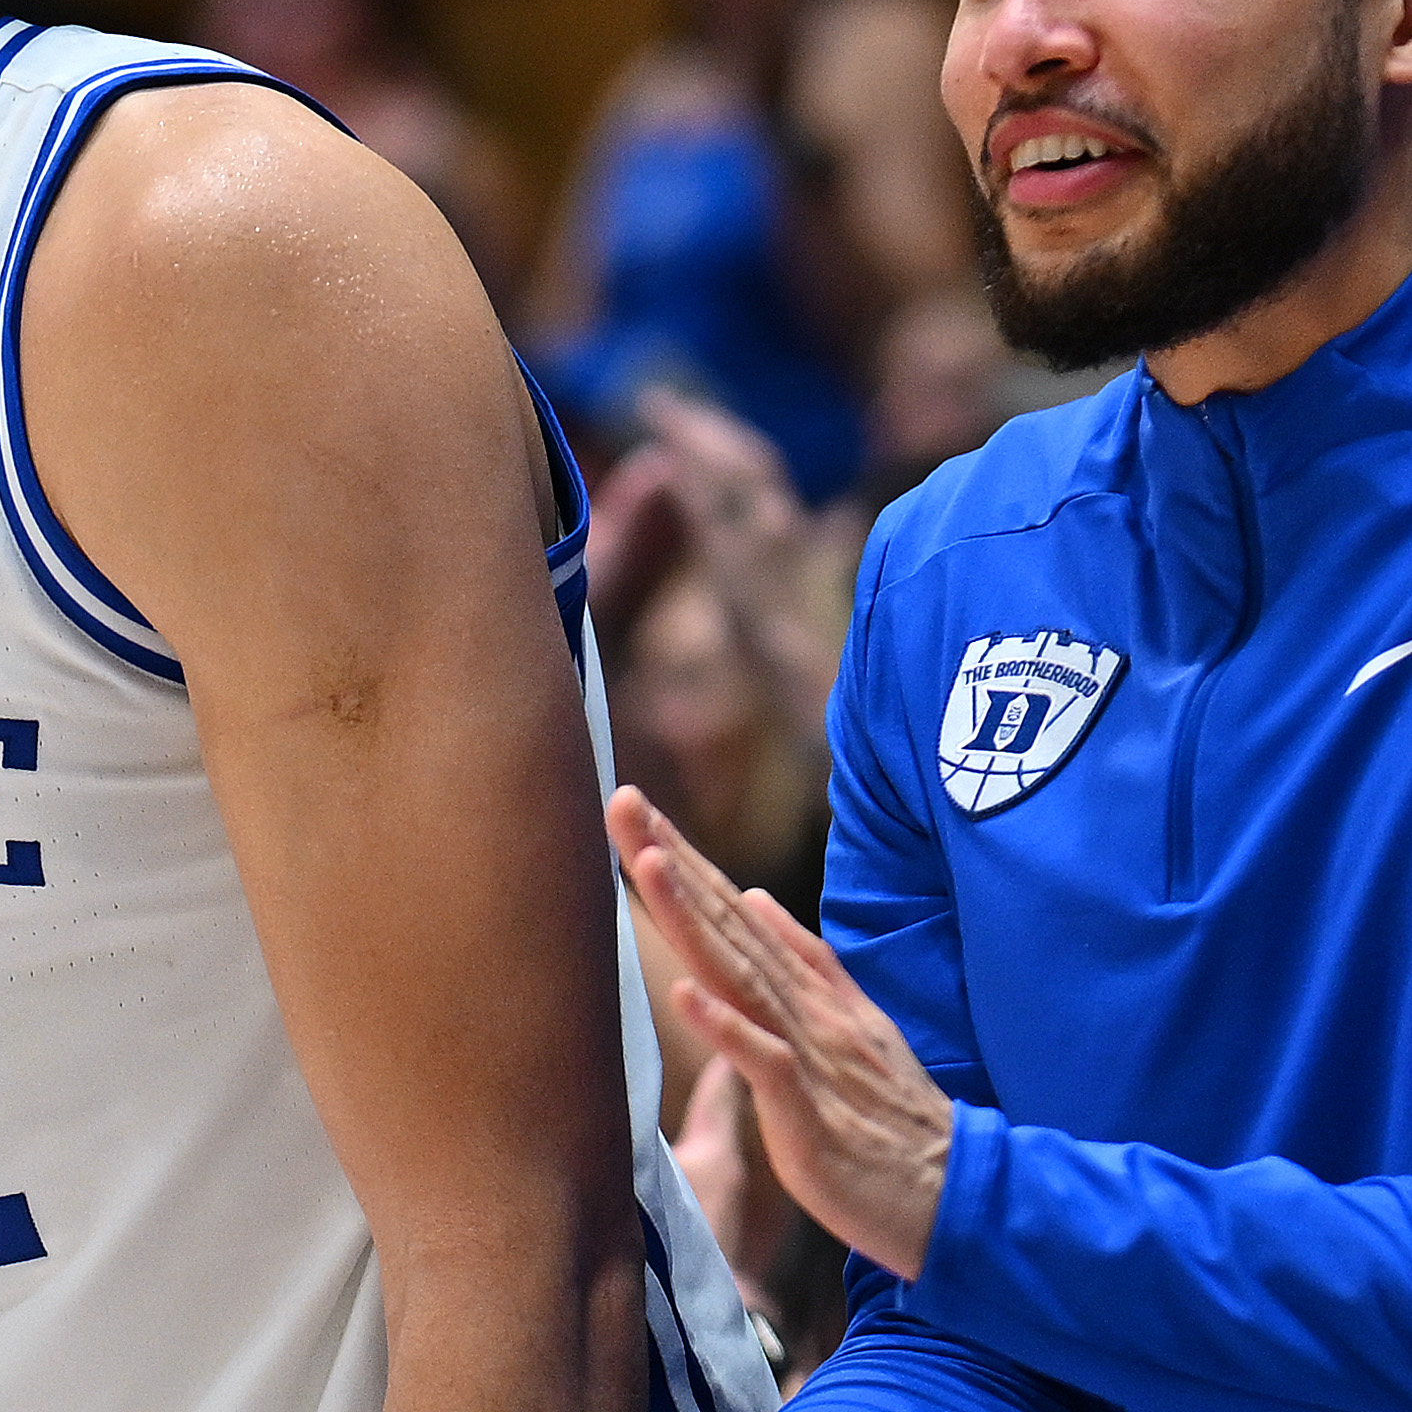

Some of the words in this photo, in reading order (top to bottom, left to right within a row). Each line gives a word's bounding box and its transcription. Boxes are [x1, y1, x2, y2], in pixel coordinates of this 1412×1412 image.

[963, 664, 993, 685] THE
[995, 660, 1100, 698] BROTHERHOOD
[961, 690, 1051, 754] D
